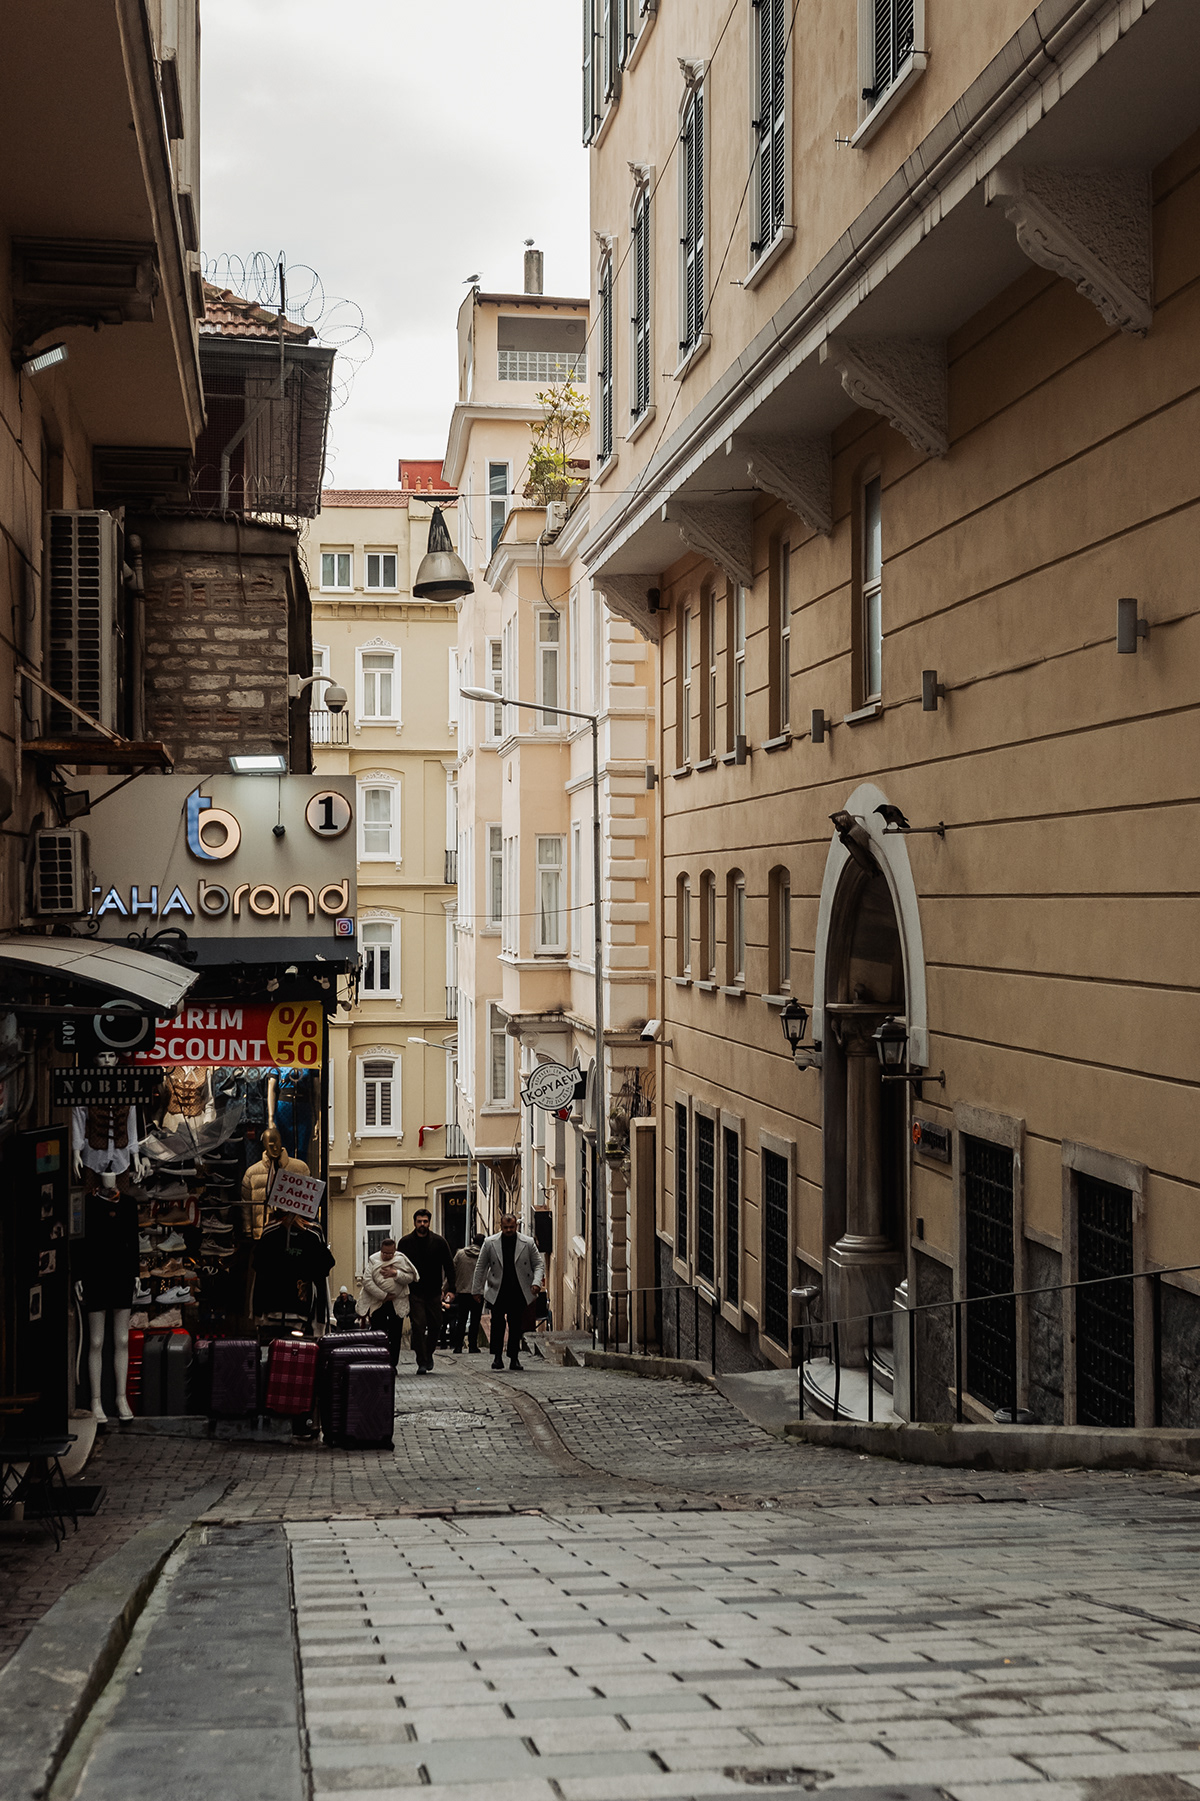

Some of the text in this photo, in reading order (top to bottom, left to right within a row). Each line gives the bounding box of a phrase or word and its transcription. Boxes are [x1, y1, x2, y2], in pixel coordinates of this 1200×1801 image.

[317, 795, 340, 831] 1
[198, 878, 350, 916] brand
[276, 1040, 318, 1065] 50
[63, 1079, 144, 1094] NOBEL
[281, 1174, 319, 1192] 500 TL
[276, 1184, 315, 1202] 3 Adet
[448, 1198, 470, 1206] GLA
[273, 1195, 314, 1214] 1000TL
